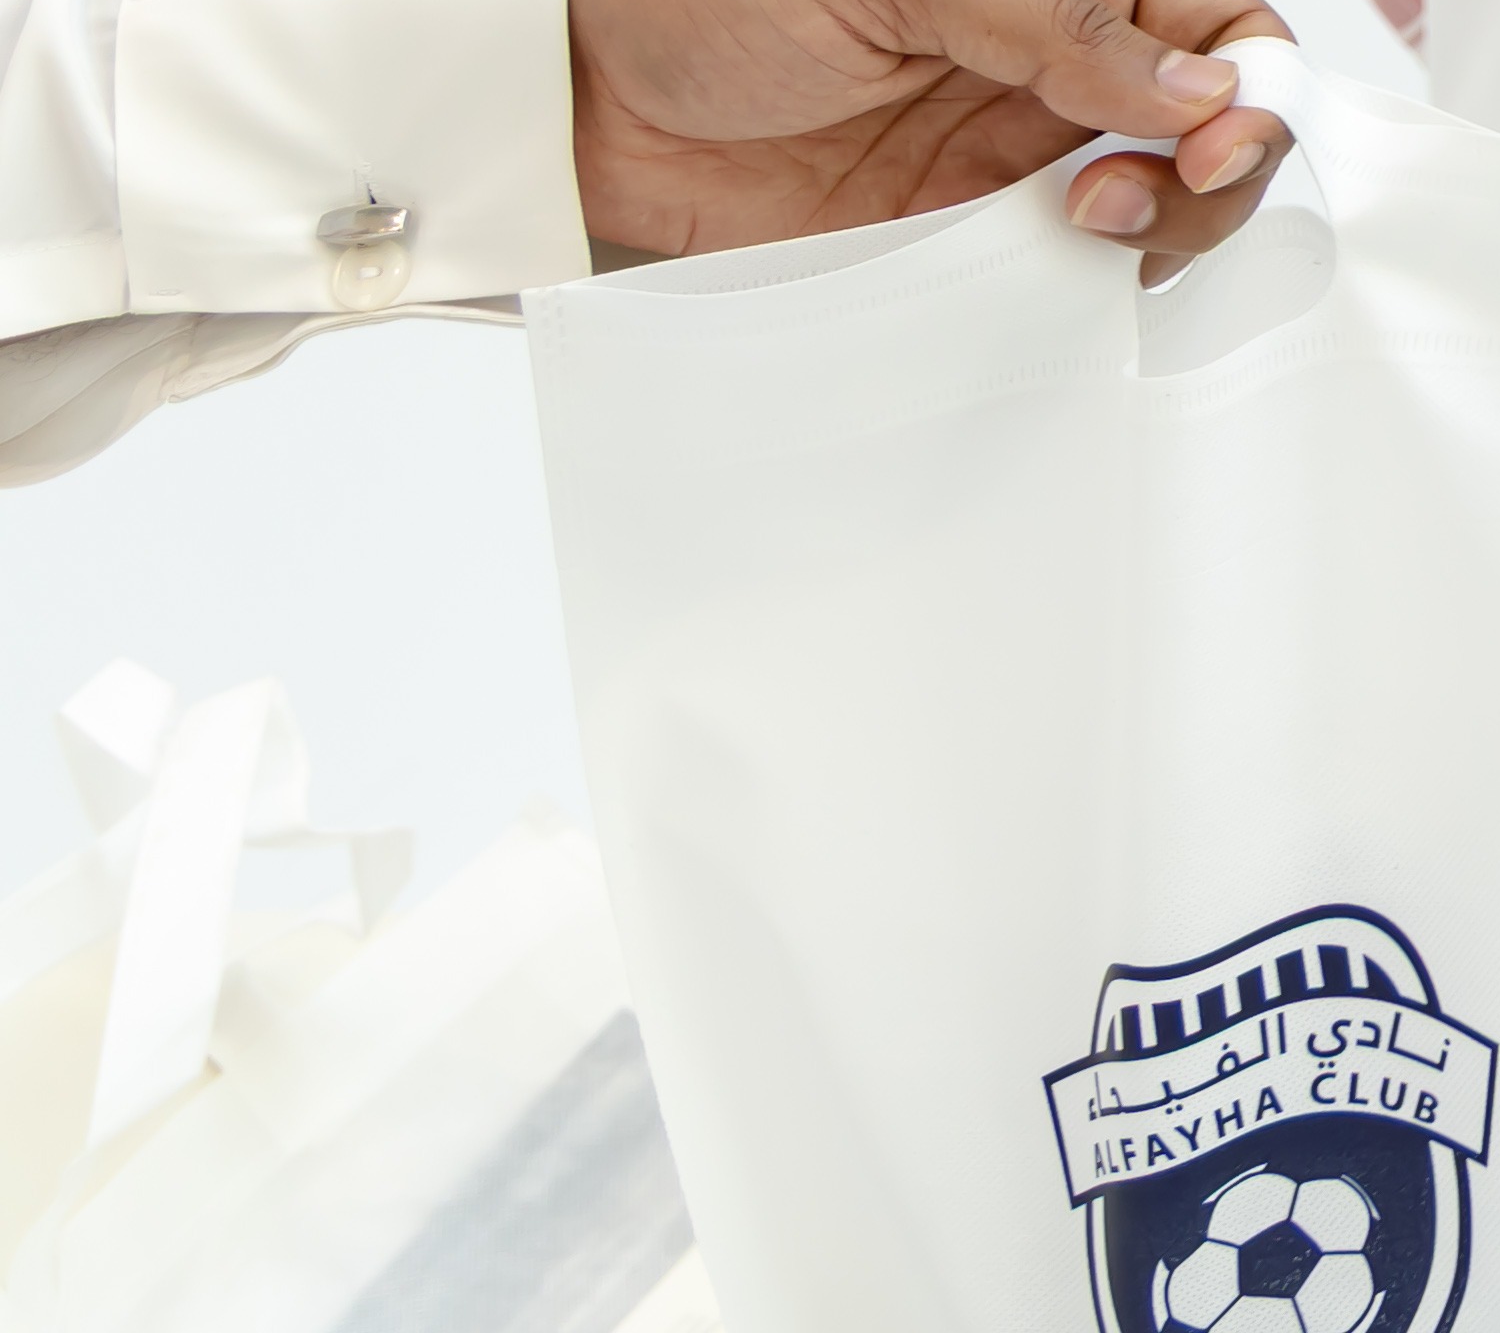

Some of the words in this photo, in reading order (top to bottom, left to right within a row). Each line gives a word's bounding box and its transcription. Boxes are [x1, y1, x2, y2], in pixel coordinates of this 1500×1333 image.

[1087, 1011, 1288, 1122] الفيحاء
[1305, 1011, 1452, 1073] نادي
[1093, 1086, 1284, 1180] ALFAYHA
[1309, 1071, 1441, 1126] CLUB
